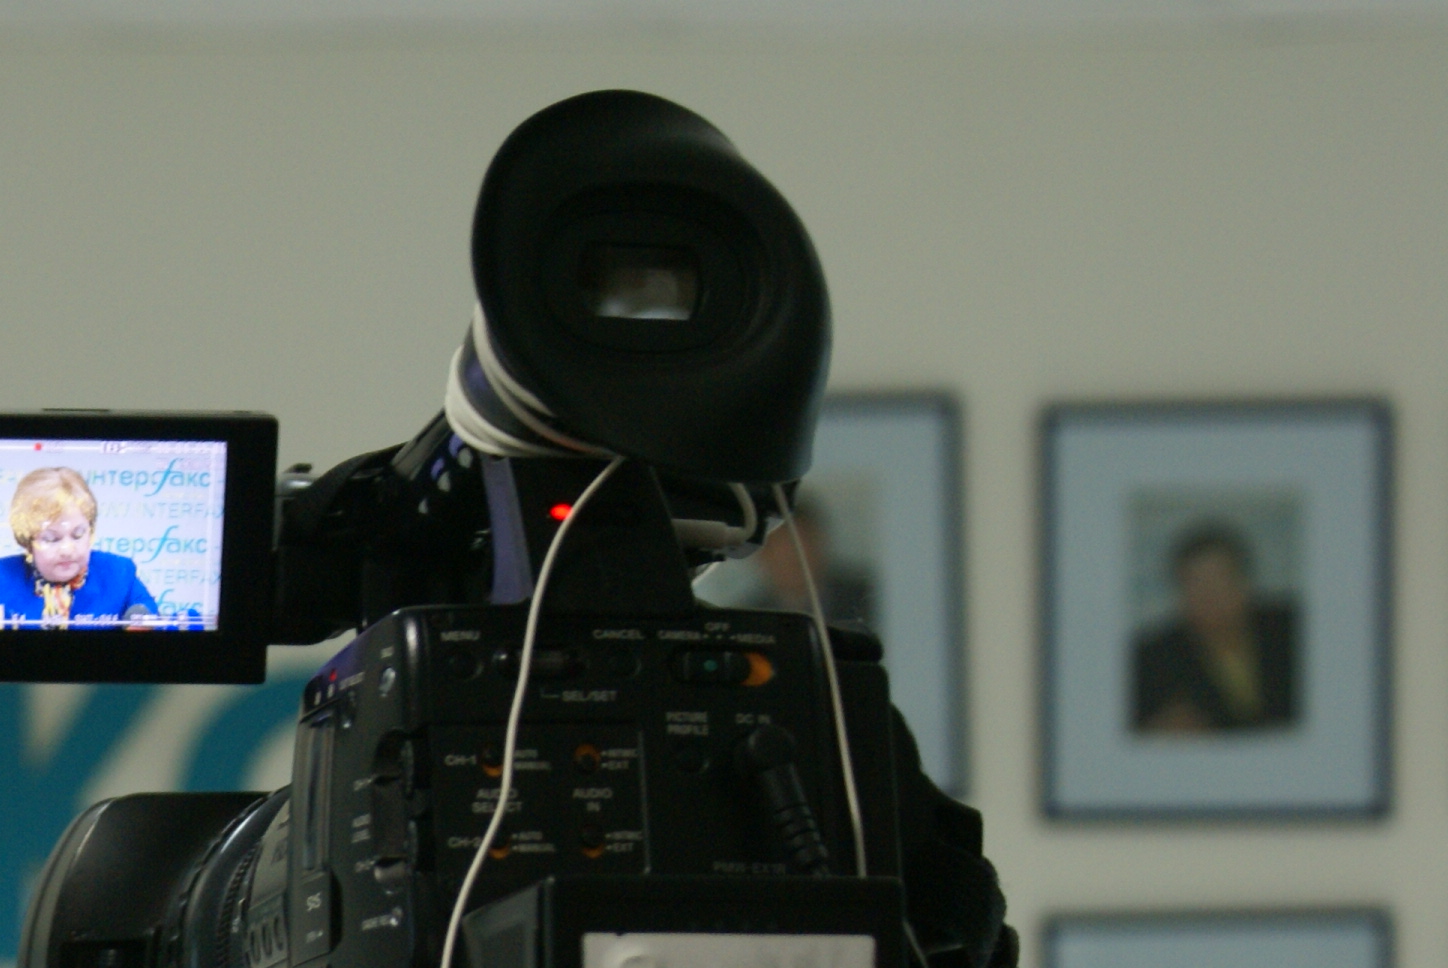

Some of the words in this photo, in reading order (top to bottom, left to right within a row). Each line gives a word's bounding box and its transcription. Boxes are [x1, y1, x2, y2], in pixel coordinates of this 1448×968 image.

[440, 629, 481, 642] MENU
[592, 628, 646, 641] CANCEL
[572, 787, 614, 800] AUDIO
